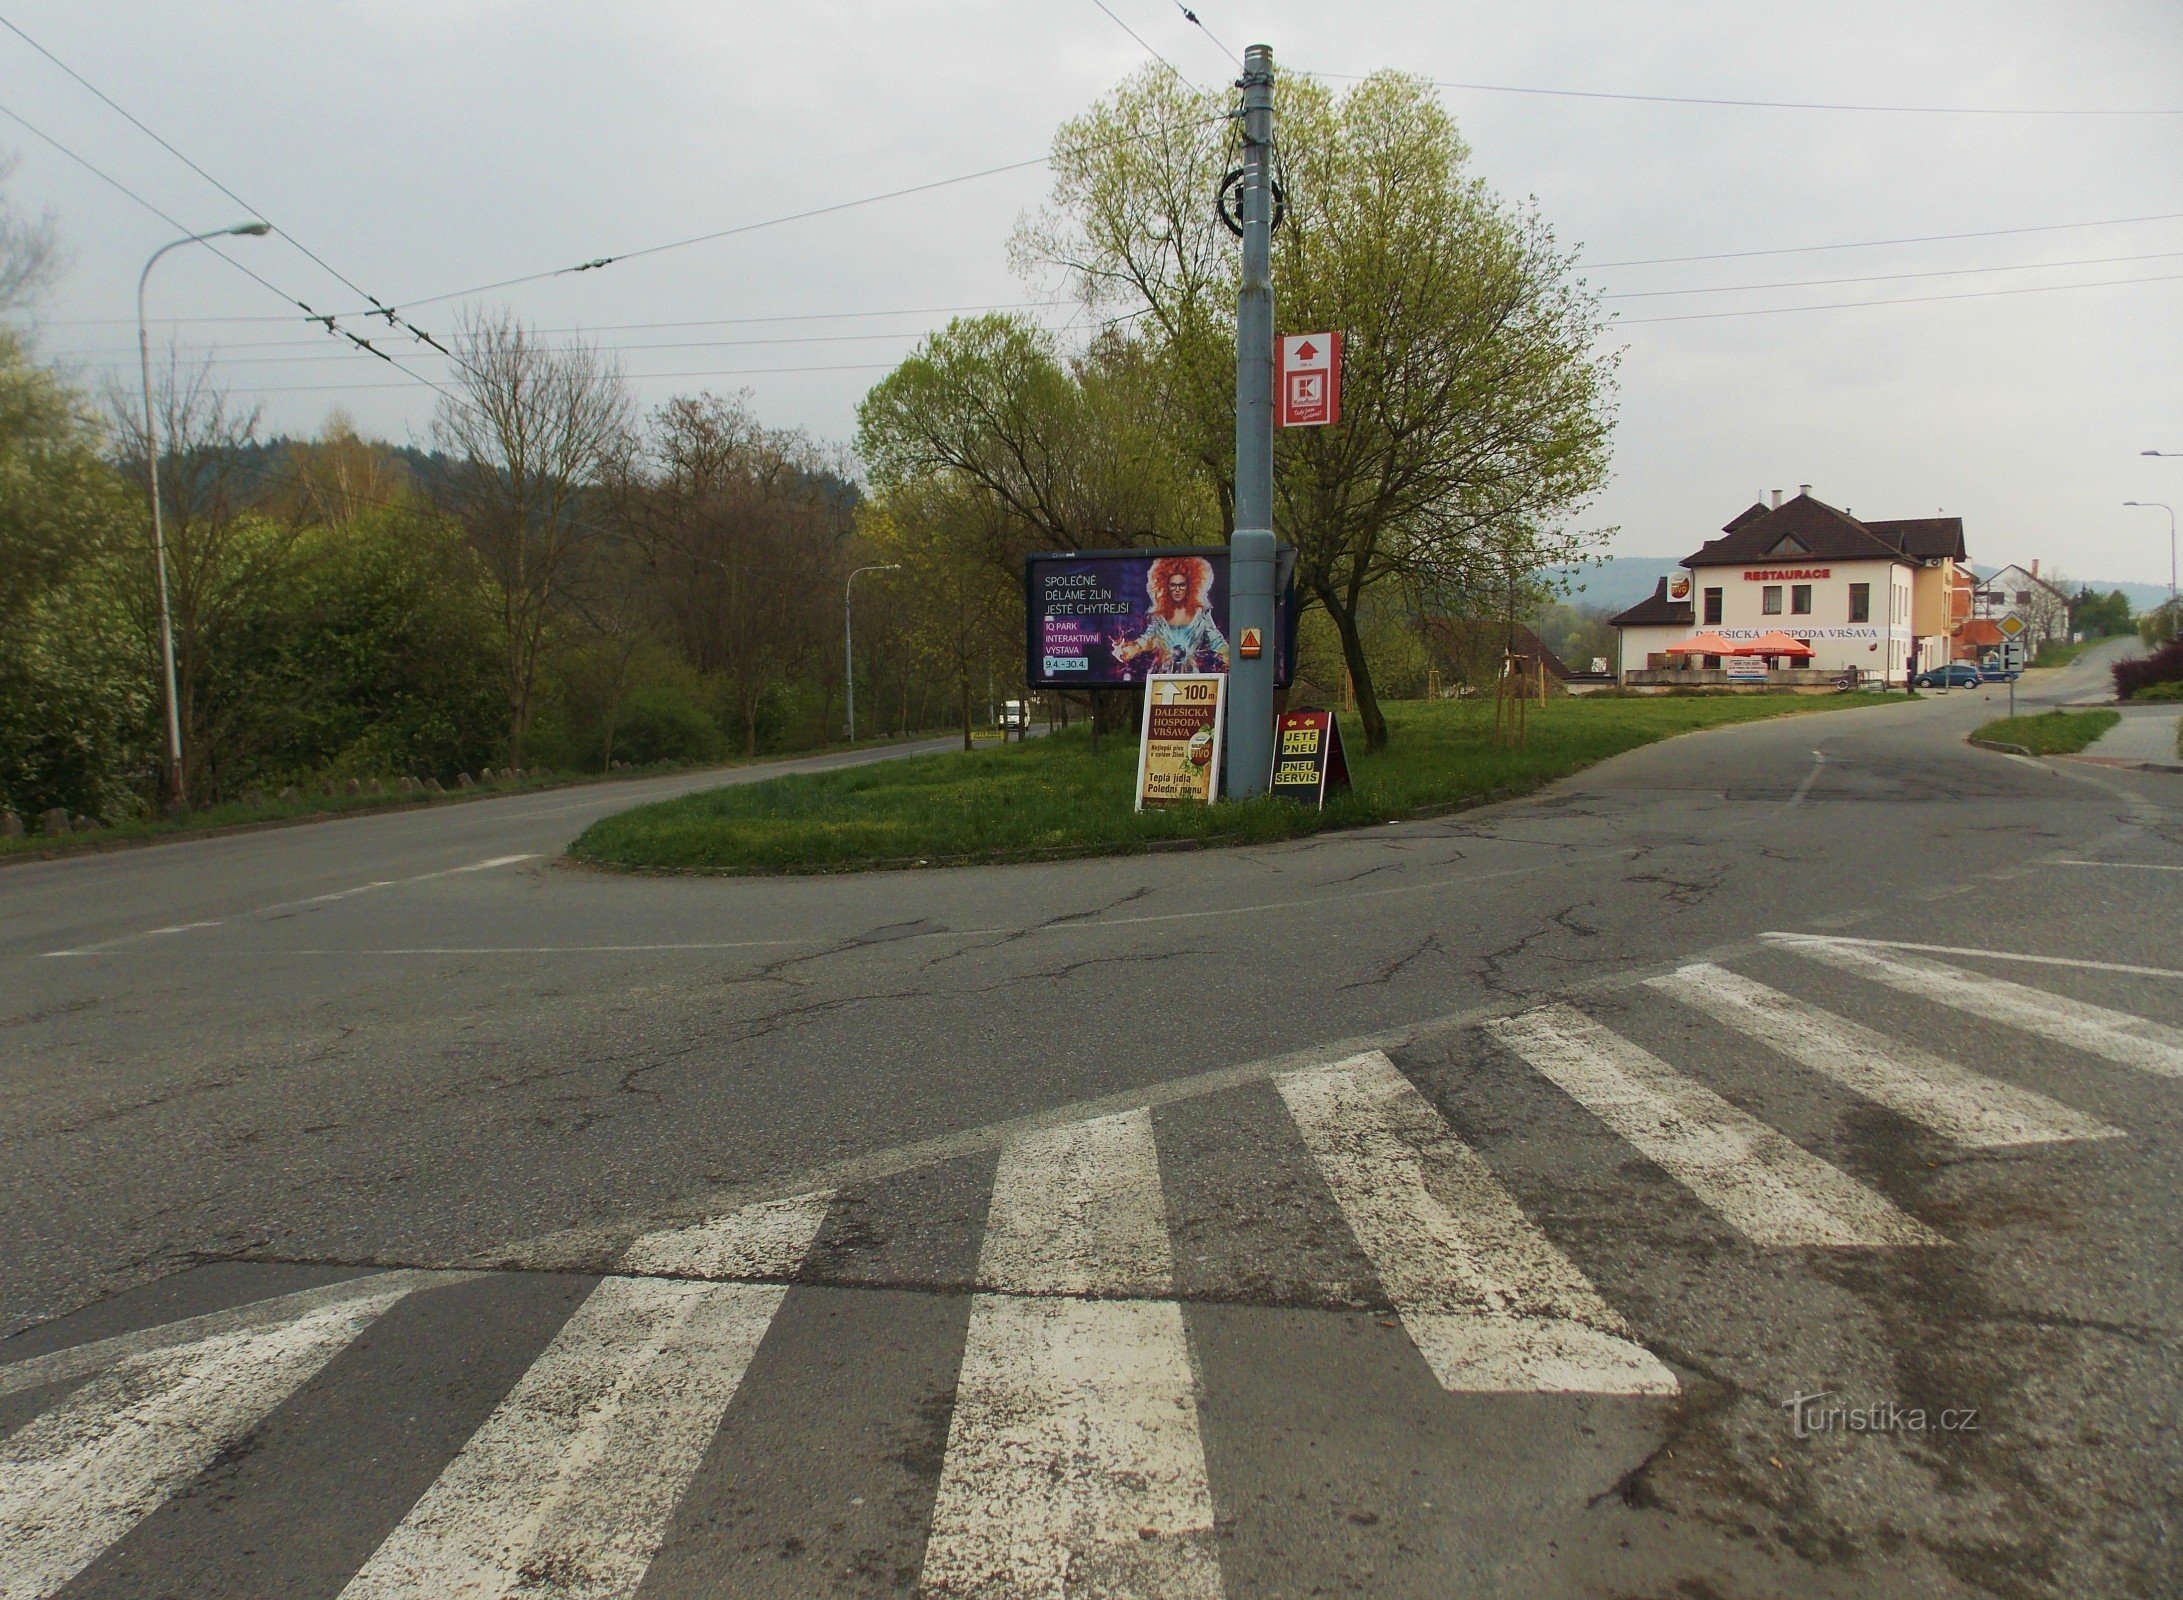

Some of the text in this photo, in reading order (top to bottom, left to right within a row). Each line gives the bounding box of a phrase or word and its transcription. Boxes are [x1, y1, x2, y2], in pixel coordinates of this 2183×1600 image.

[1045, 575, 1096, 586] SPOLEČNĚ
[1743, 569, 1831, 581] RESTAURACE
[1045, 589, 1112, 600] DĚLÁME ZLÍN
[1045, 602, 1129, 614] JEŠTĚ CHYTŘEJŠÍ
[1045, 622, 1077, 631] IQ PARK
[1045, 633, 1099, 642] INTERAKTIVNÍ
[1828, 628, 1878, 639] VRŠAVA
[1045, 645, 1080, 654] VÝSTAVA
[1184, 684, 1208, 700] 100
[1154, 706, 1209, 717] DALEŠICKÁ
[1153, 718, 1201, 727] HOSPODA
[1153, 726, 1190, 736] VRŠAVA
[1285, 729, 1317, 742] JETÉ
[1284, 743, 1317, 754] PNEU
[1282, 762, 1314, 772] PNEU
[1149, 772, 1192, 784] Teplá jídla
[1275, 772, 1318, 783] SERVIS
[1148, 783, 1203, 795] Polední menu
